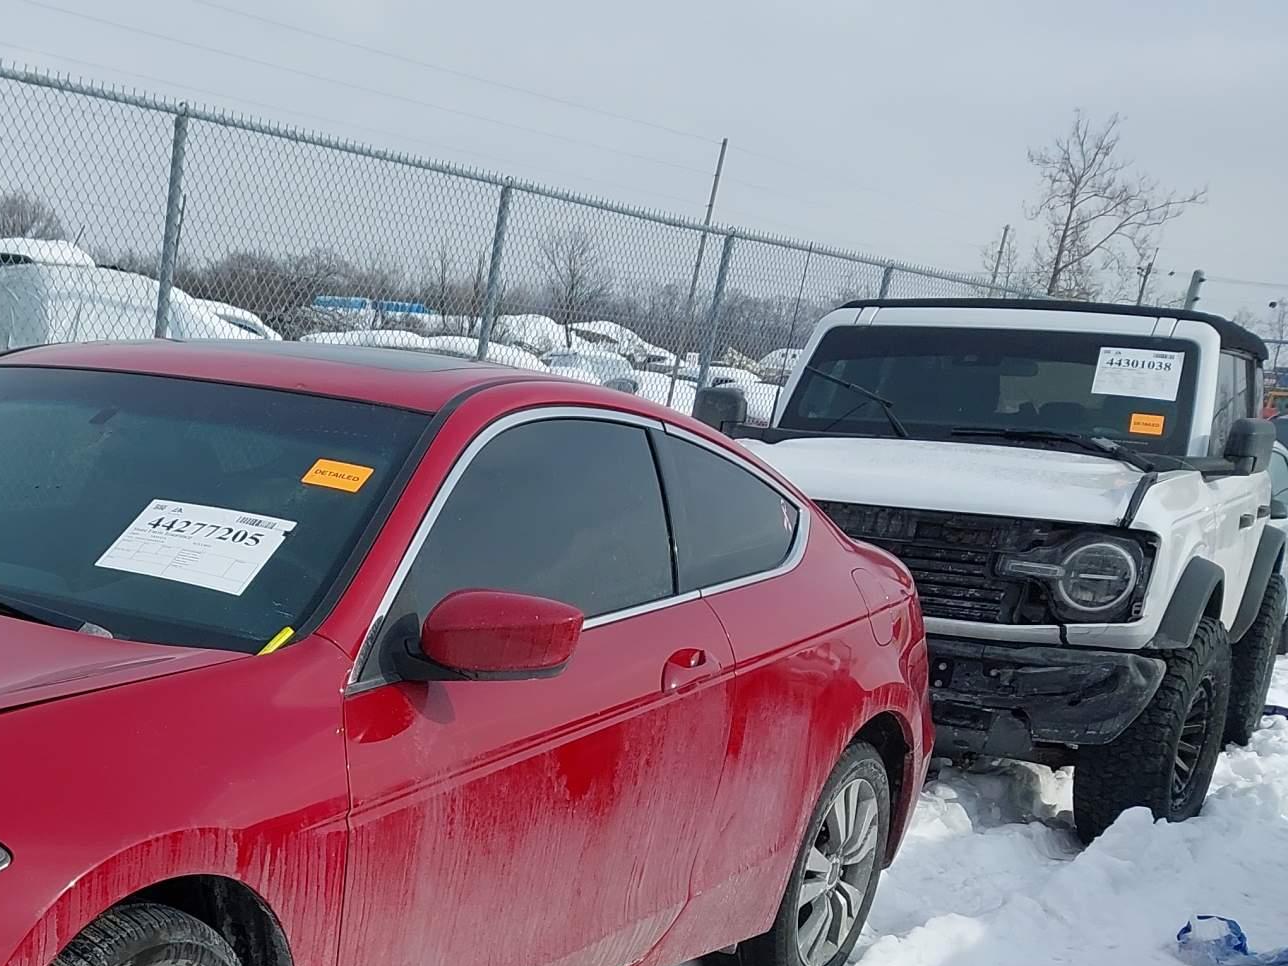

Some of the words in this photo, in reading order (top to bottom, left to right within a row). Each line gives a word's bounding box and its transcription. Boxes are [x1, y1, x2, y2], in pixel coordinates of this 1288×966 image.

[1105, 357, 1172, 371] 44301038
[314, 468, 360, 482] DETAILED
[147, 516, 265, 547] 44277205
